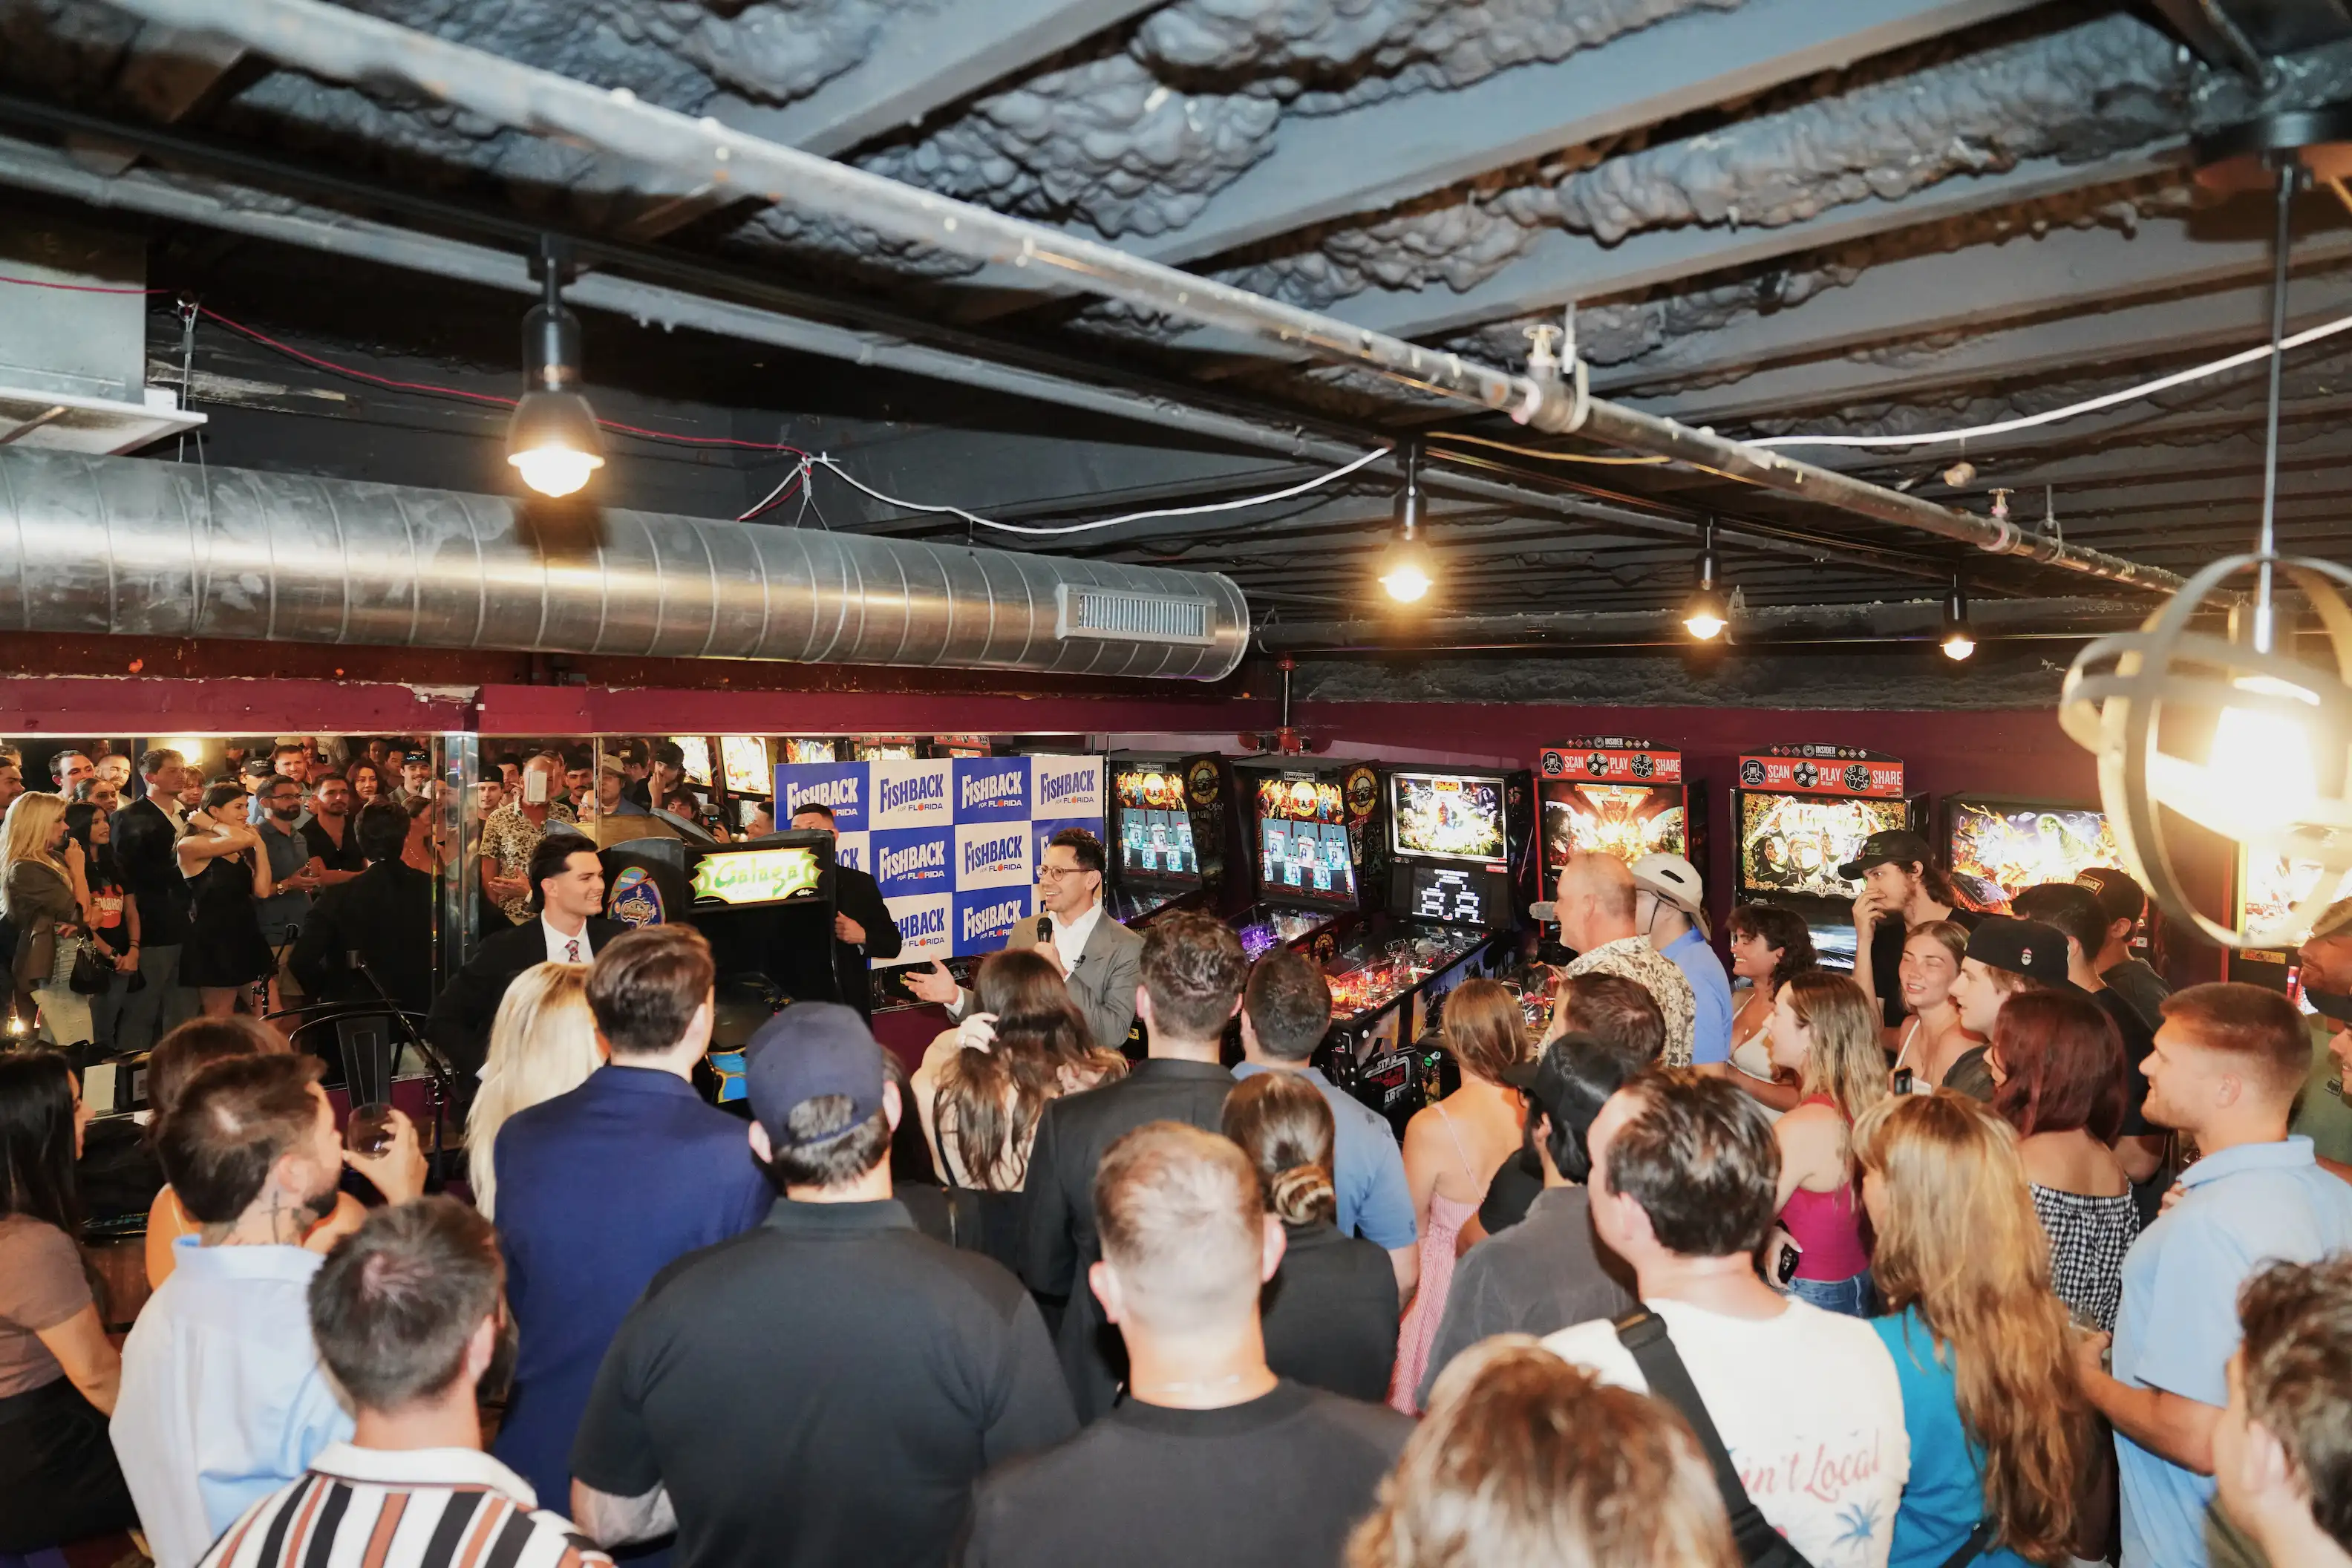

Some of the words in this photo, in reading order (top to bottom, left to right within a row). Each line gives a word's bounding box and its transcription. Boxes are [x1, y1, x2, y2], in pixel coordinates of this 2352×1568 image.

[1604, 737, 1624, 745] INSIDER
[1815, 745, 1836, 754] INSIDER
[1564, 755, 1584, 769] SCAN
[1609, 757, 1628, 771] PLAY
[1655, 758, 1681, 773] SHARE
[1768, 764, 1790, 779] SCAN
[1820, 767, 1841, 782] PLAY
[1872, 769, 1902, 785] SHARE
[880, 774, 944, 814] FISHBACK
[961, 771, 1022, 809] FISHBACK
[1041, 770, 1094, 805] FISHBACK
[879, 840, 945, 883] FISHBACK
[964, 835, 1022, 875] FISHBACK
[963, 899, 1022, 941] FISHBACK
[1376, 1054, 1397, 1070] STAR
[1385, 1090, 1400, 1104] ARS
[1803, 1428, 1880, 1503] Local
